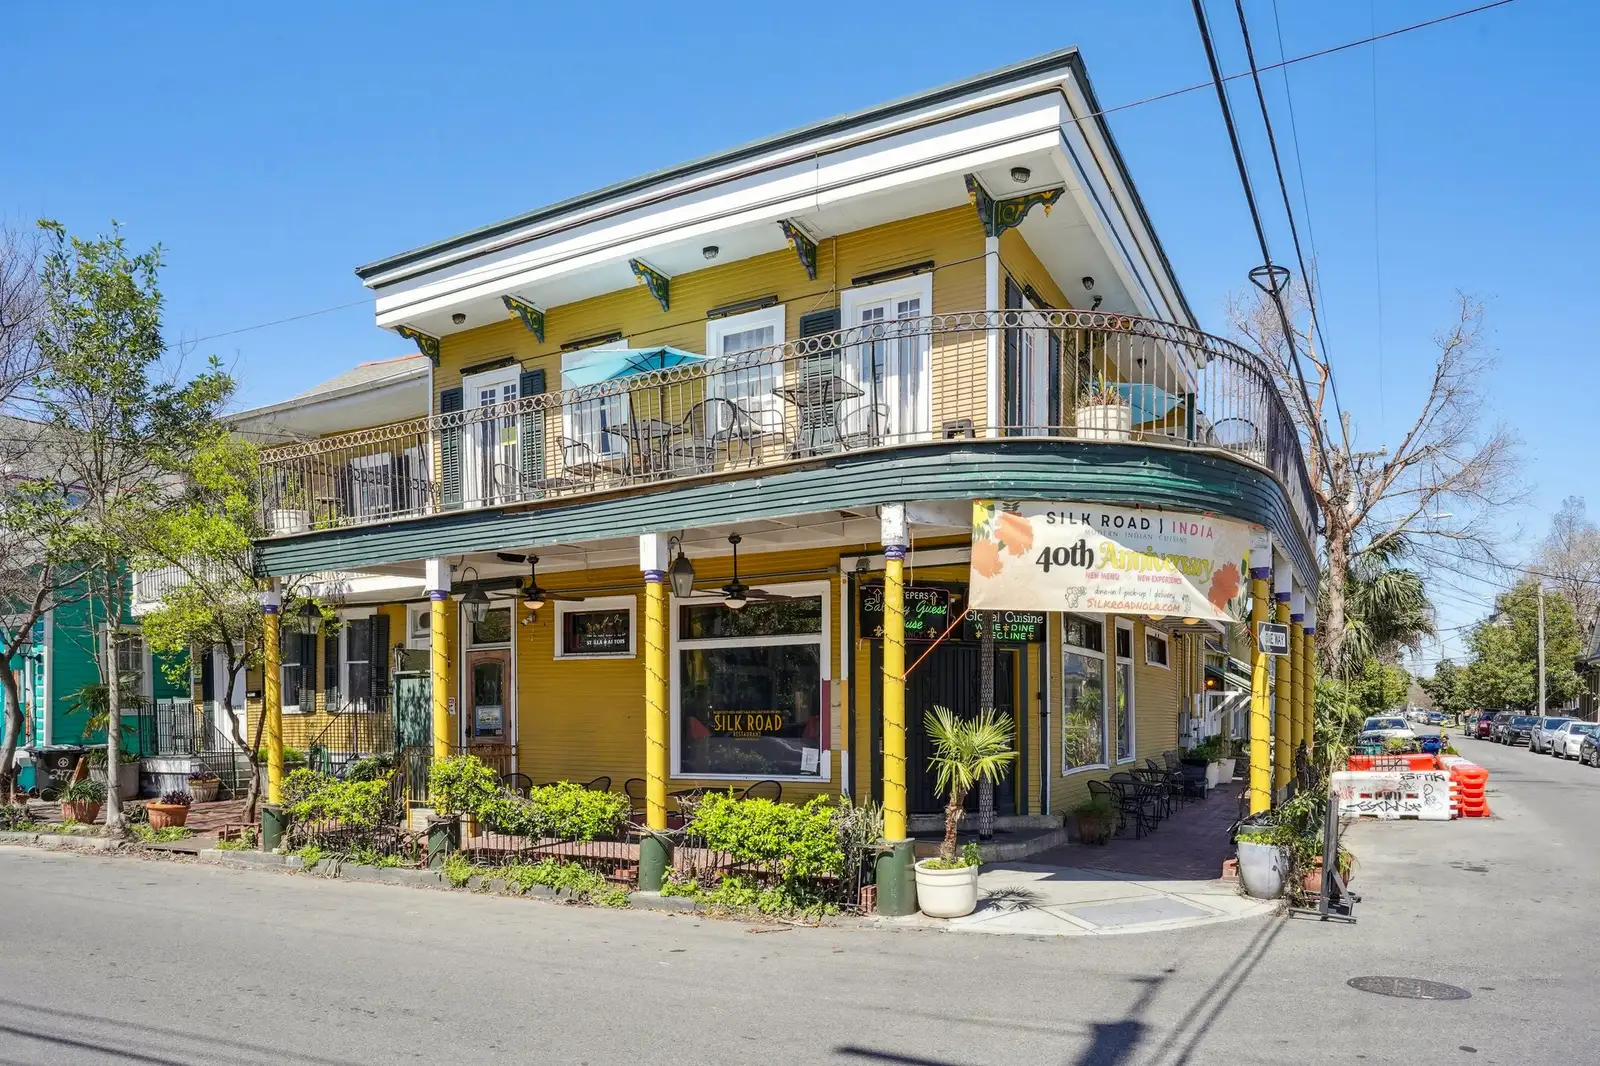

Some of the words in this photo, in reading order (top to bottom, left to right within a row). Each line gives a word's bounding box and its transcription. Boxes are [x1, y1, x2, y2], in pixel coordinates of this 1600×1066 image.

[1046, 511, 1091, 526] SILK
[1101, 514, 1150, 530] ROAD
[1172, 521, 1213, 539] INDIA
[1084, 529, 1119, 537] MODERN
[1124, 532, 1153, 540] INDIAN
[1158, 535, 1187, 544] CUISINE
[1035, 538, 1094, 573] 40th
[1095, 541, 1215, 584] Anniversary
[1085, 571, 1099, 580] NEW
[1100, 572, 1120, 581] MENU
[1137, 574, 1151, 583] NEW
[1151, 575, 1182, 585] EXPERIENCE
[915, 600, 947, 619] Guest
[1086, 597, 1180, 613] SILKROADNOLA.COM
[1005, 611, 1043, 624] Cuisine
[1011, 624, 1035, 633] DINE
[714, 714, 742, 731] SILK
[747, 714, 782, 731] ROAD
